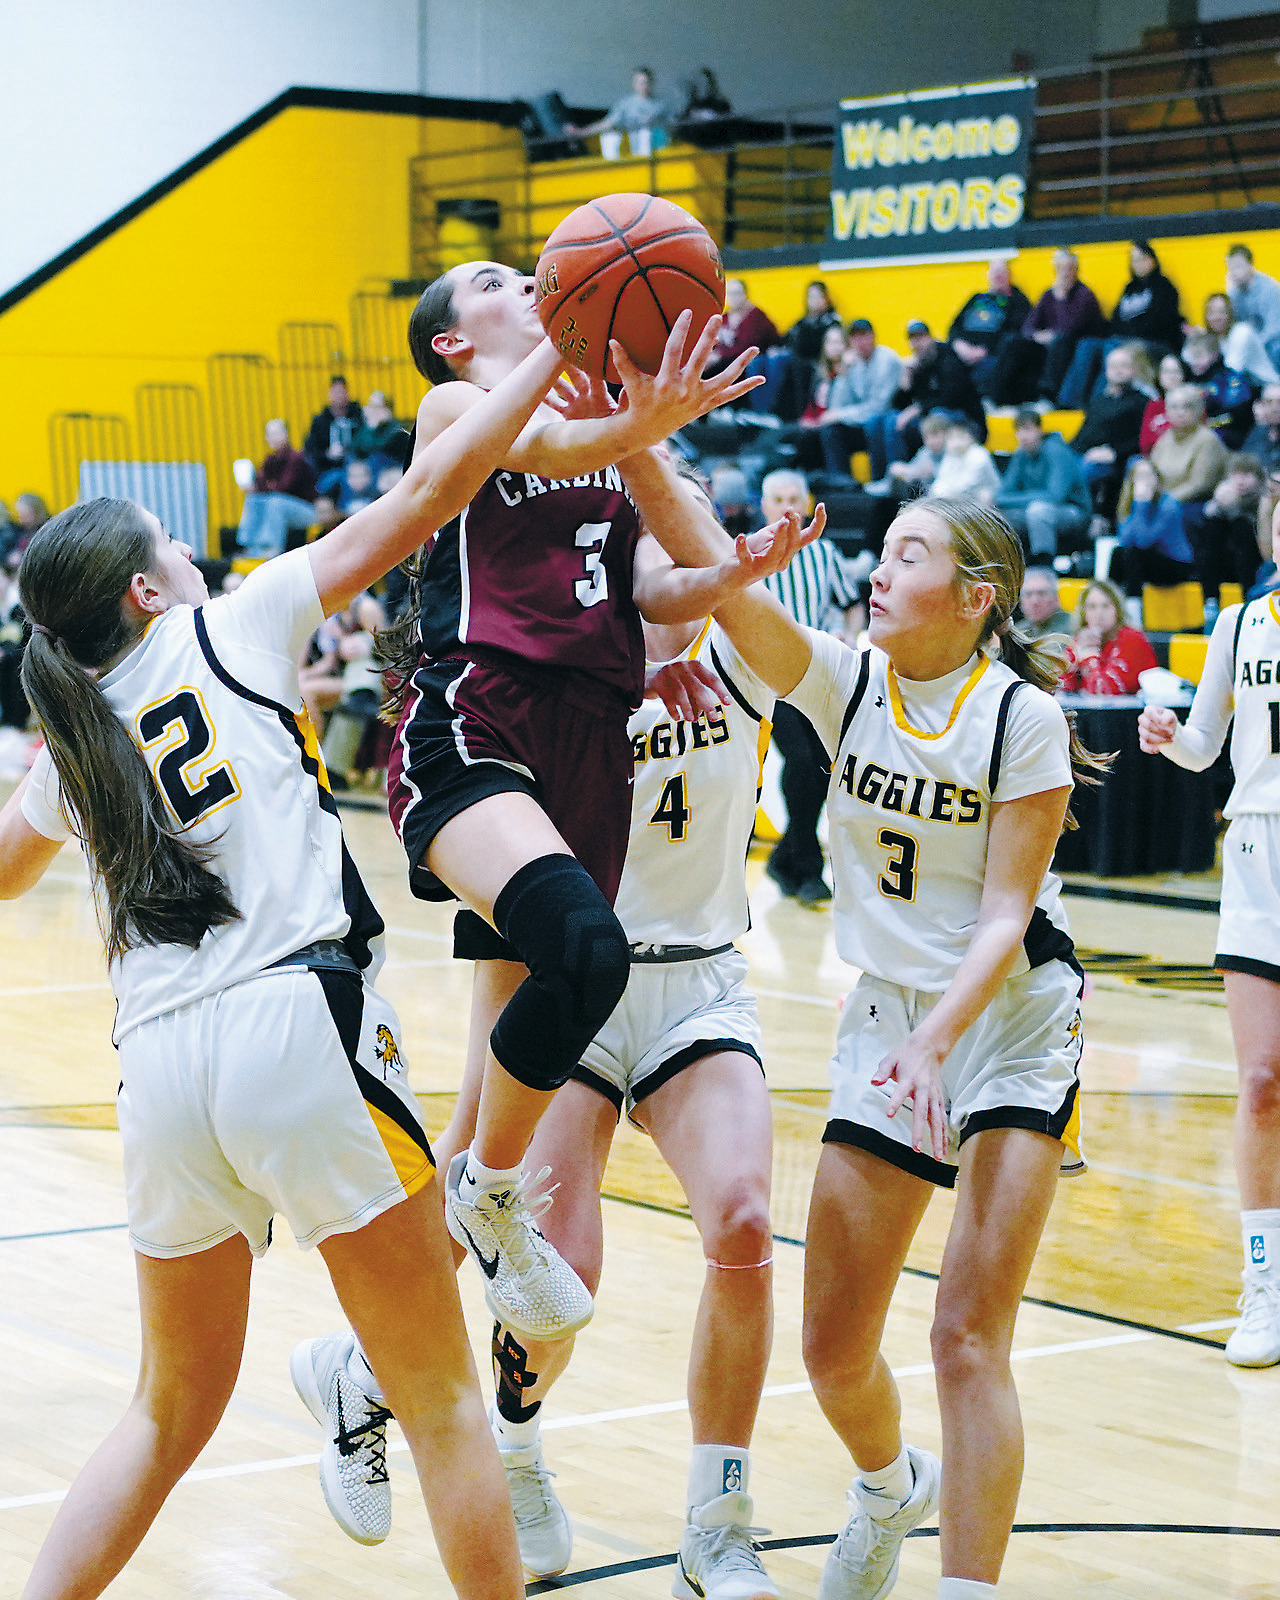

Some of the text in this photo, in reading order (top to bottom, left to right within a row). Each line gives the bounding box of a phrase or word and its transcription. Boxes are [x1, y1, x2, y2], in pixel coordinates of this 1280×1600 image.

[841, 114, 1021, 170] Welcome
[830, 173, 1026, 241] VISITORS
[575, 521, 612, 608] 3
[136, 686, 242, 831] 2
[838, 752, 984, 825] AGGIES
[647, 770, 692, 842] 4
[877, 826, 920, 903] 3
